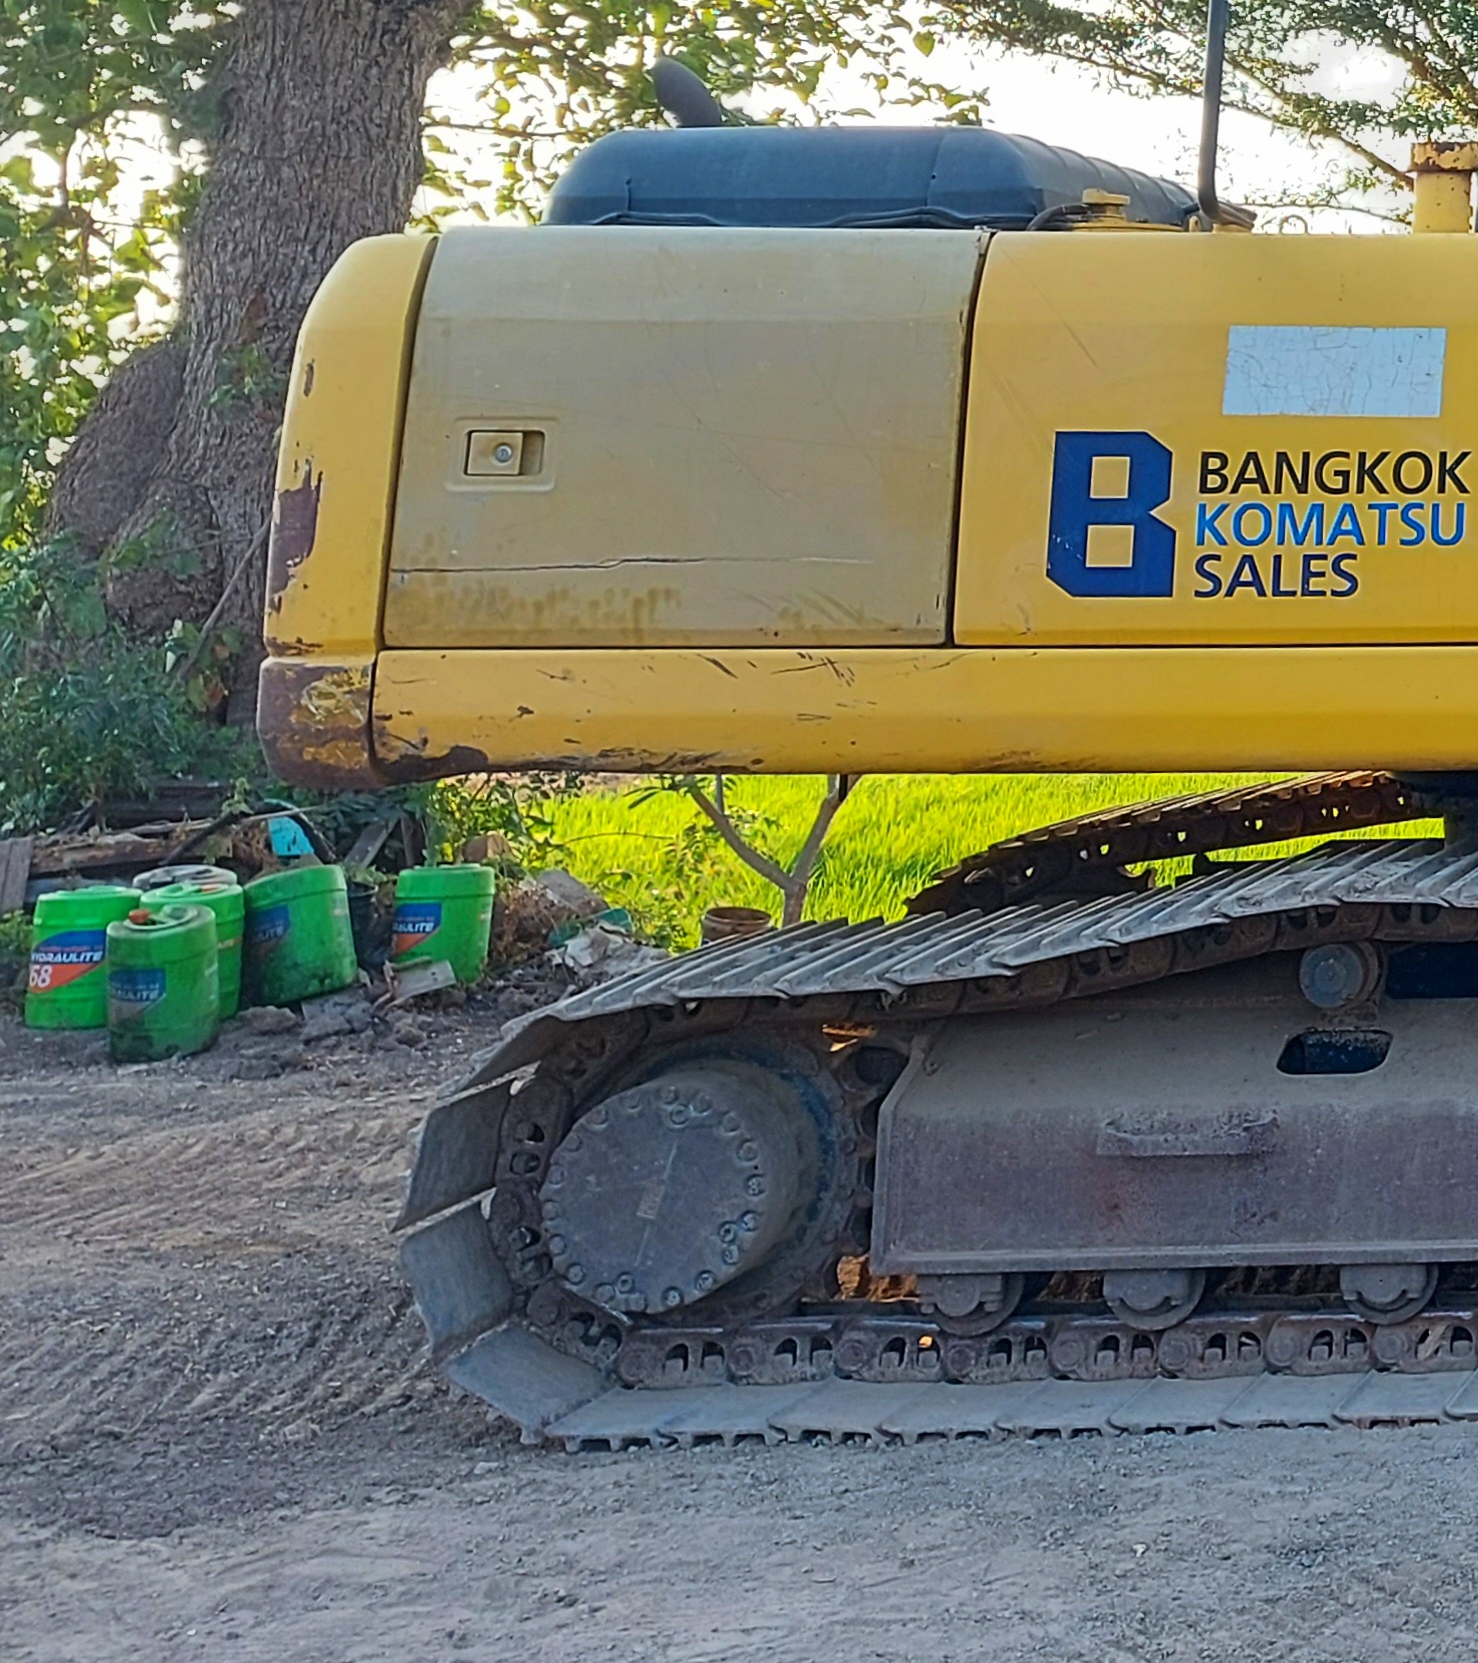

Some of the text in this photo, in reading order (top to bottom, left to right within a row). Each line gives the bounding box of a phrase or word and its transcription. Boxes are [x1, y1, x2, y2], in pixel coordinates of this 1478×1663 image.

[1199, 451, 1472, 495] BANGKOK
[1195, 502, 1465, 546] KOMATSU
[1193, 553, 1360, 598] SALES
